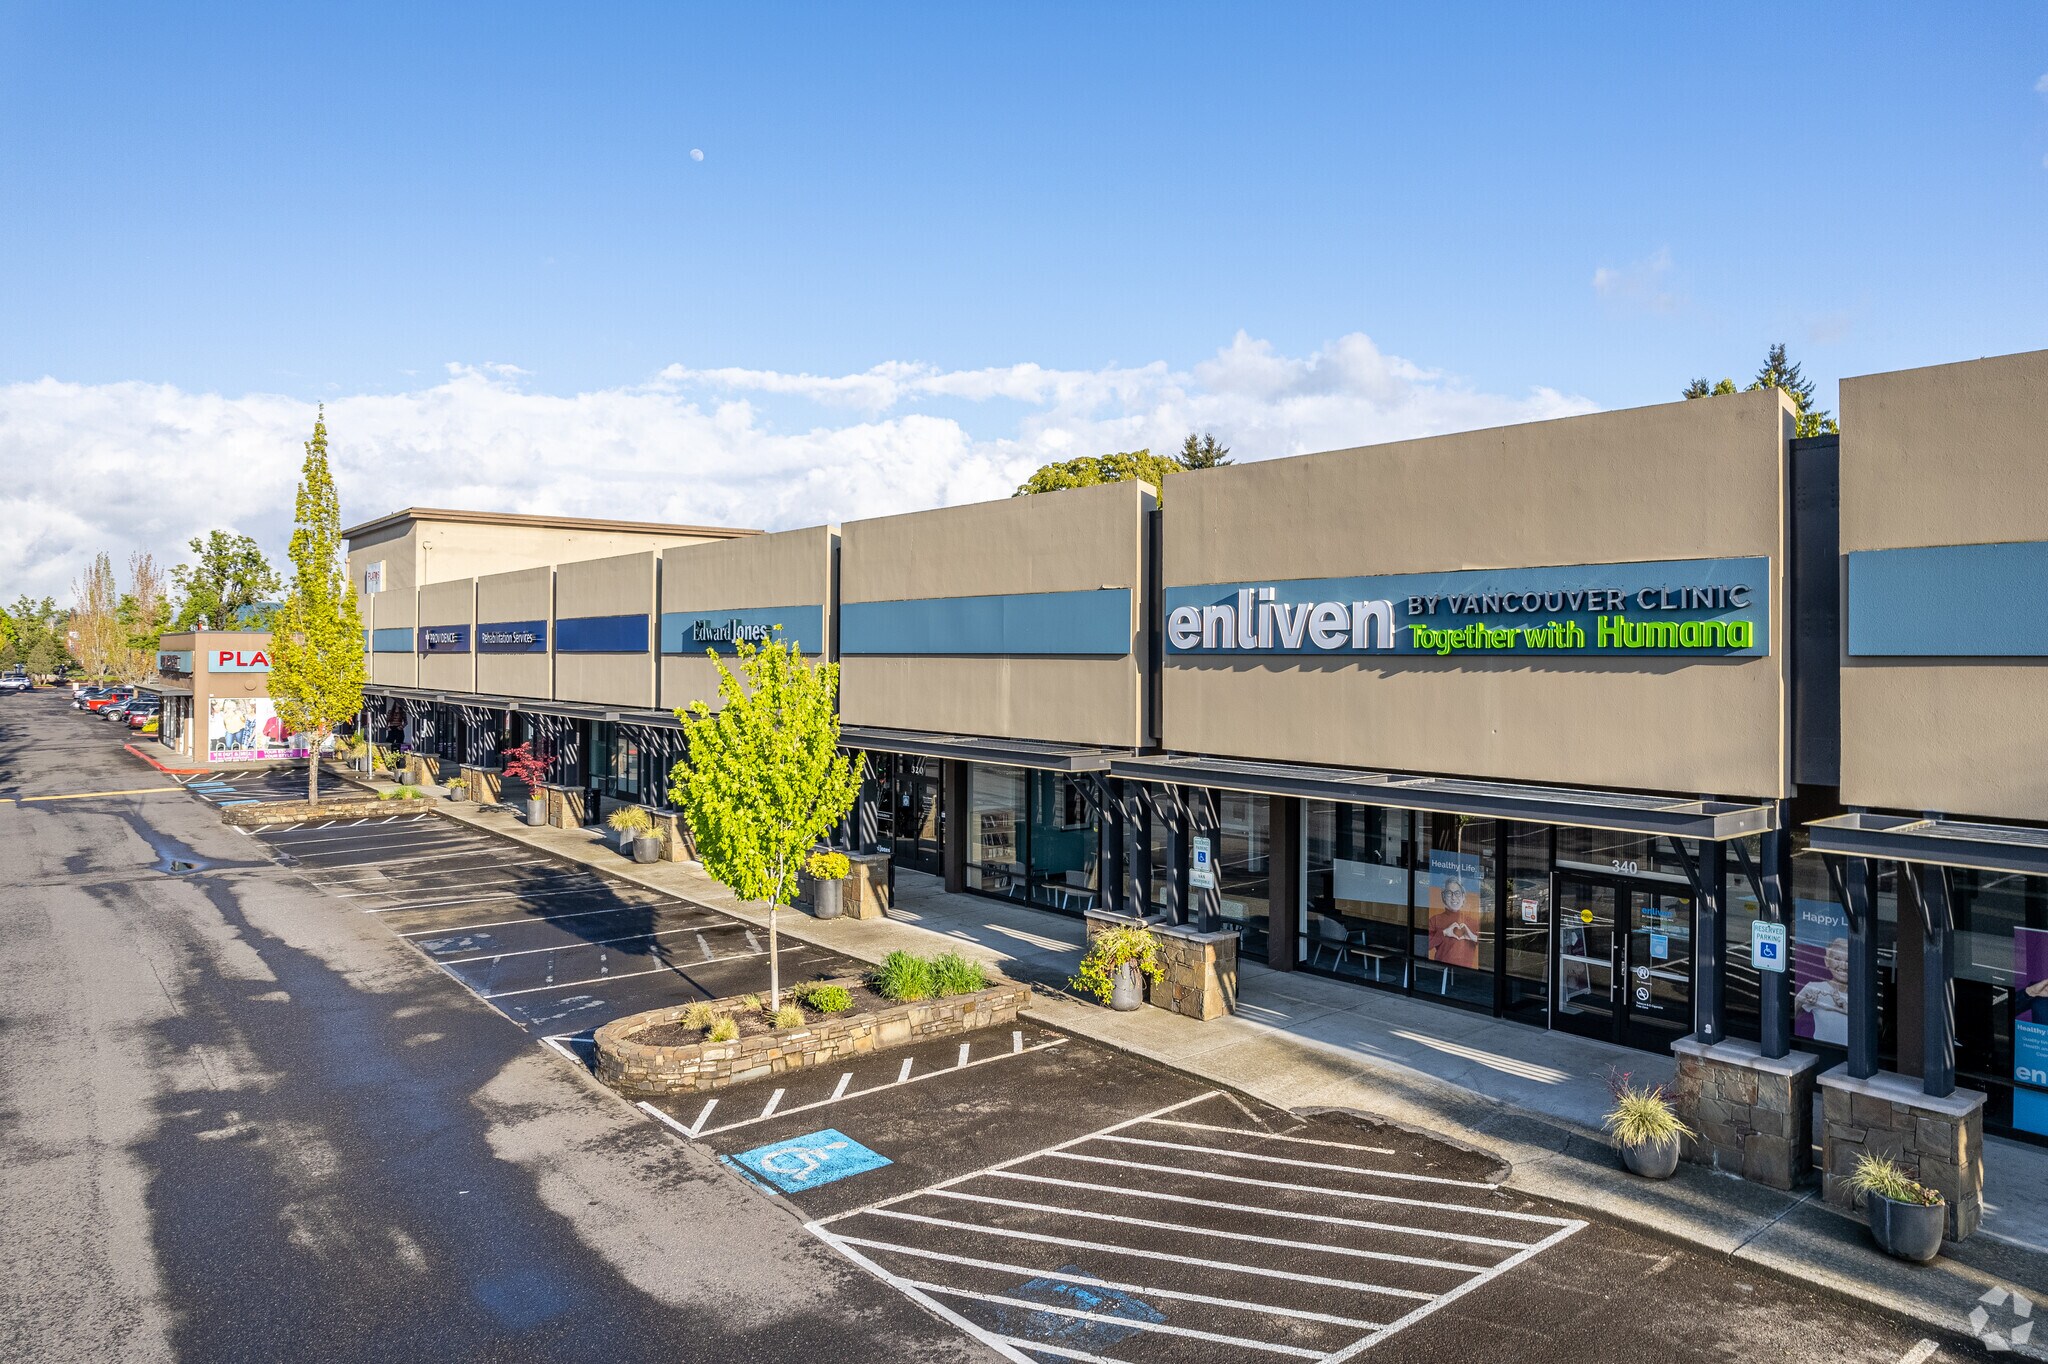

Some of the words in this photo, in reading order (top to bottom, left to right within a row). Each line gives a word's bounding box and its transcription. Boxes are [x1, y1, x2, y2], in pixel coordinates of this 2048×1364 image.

[1408, 595, 1439, 616] BY
[1446, 589, 1626, 615] VANCOUVER
[1636, 584, 1752, 610] CLINIC
[1168, 587, 1396, 650] enliven
[694, 620, 730, 641] Edward
[1409, 622, 1521, 656] Together
[1524, 620, 1585, 649] with
[1597, 615, 1753, 649] Humana
[429, 632, 456, 643] PROVIDENCE
[482, 632, 512, 644] Rehabilitation
[512, 631, 534, 644] Services
[219, 651, 275, 667] PLA
[911, 766, 924, 775] 320
[1431, 859, 1460, 871] Healthy
[1461, 863, 1478, 872] Life.
[1612, 860, 1638, 874] 340
[1802, 911, 1838, 927] Happy
[1754, 924, 1783, 935] RESERVED
[1756, 933, 1781, 943] PARKING
[2017, 1024, 2046, 1036] Healthy
